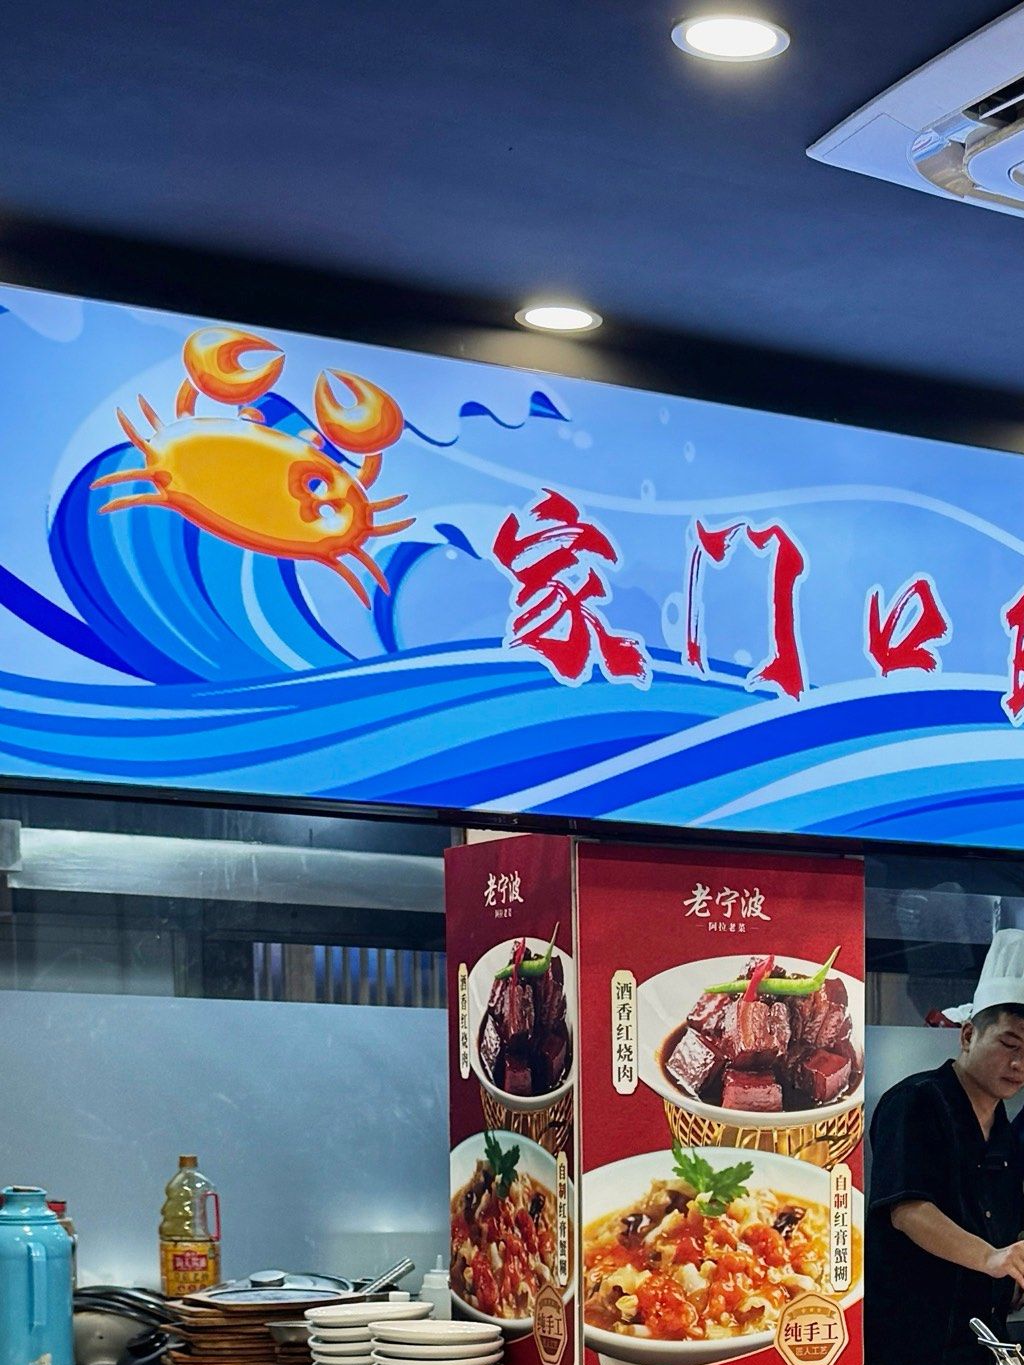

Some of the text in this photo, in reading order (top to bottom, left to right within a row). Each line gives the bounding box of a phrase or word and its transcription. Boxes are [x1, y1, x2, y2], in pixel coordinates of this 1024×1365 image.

[484, 871, 524, 907] 老宁波
[683, 883, 771, 921] 老宁波
[708, 921, 746, 933] 阿拉老菜
[616, 981, 633, 1083] 酒香红烧肉
[833, 1174, 848, 1283] 自制红膏蟹糊
[537, 1313, 563, 1335] 纯手工
[784, 1321, 839, 1344] 纯手工
